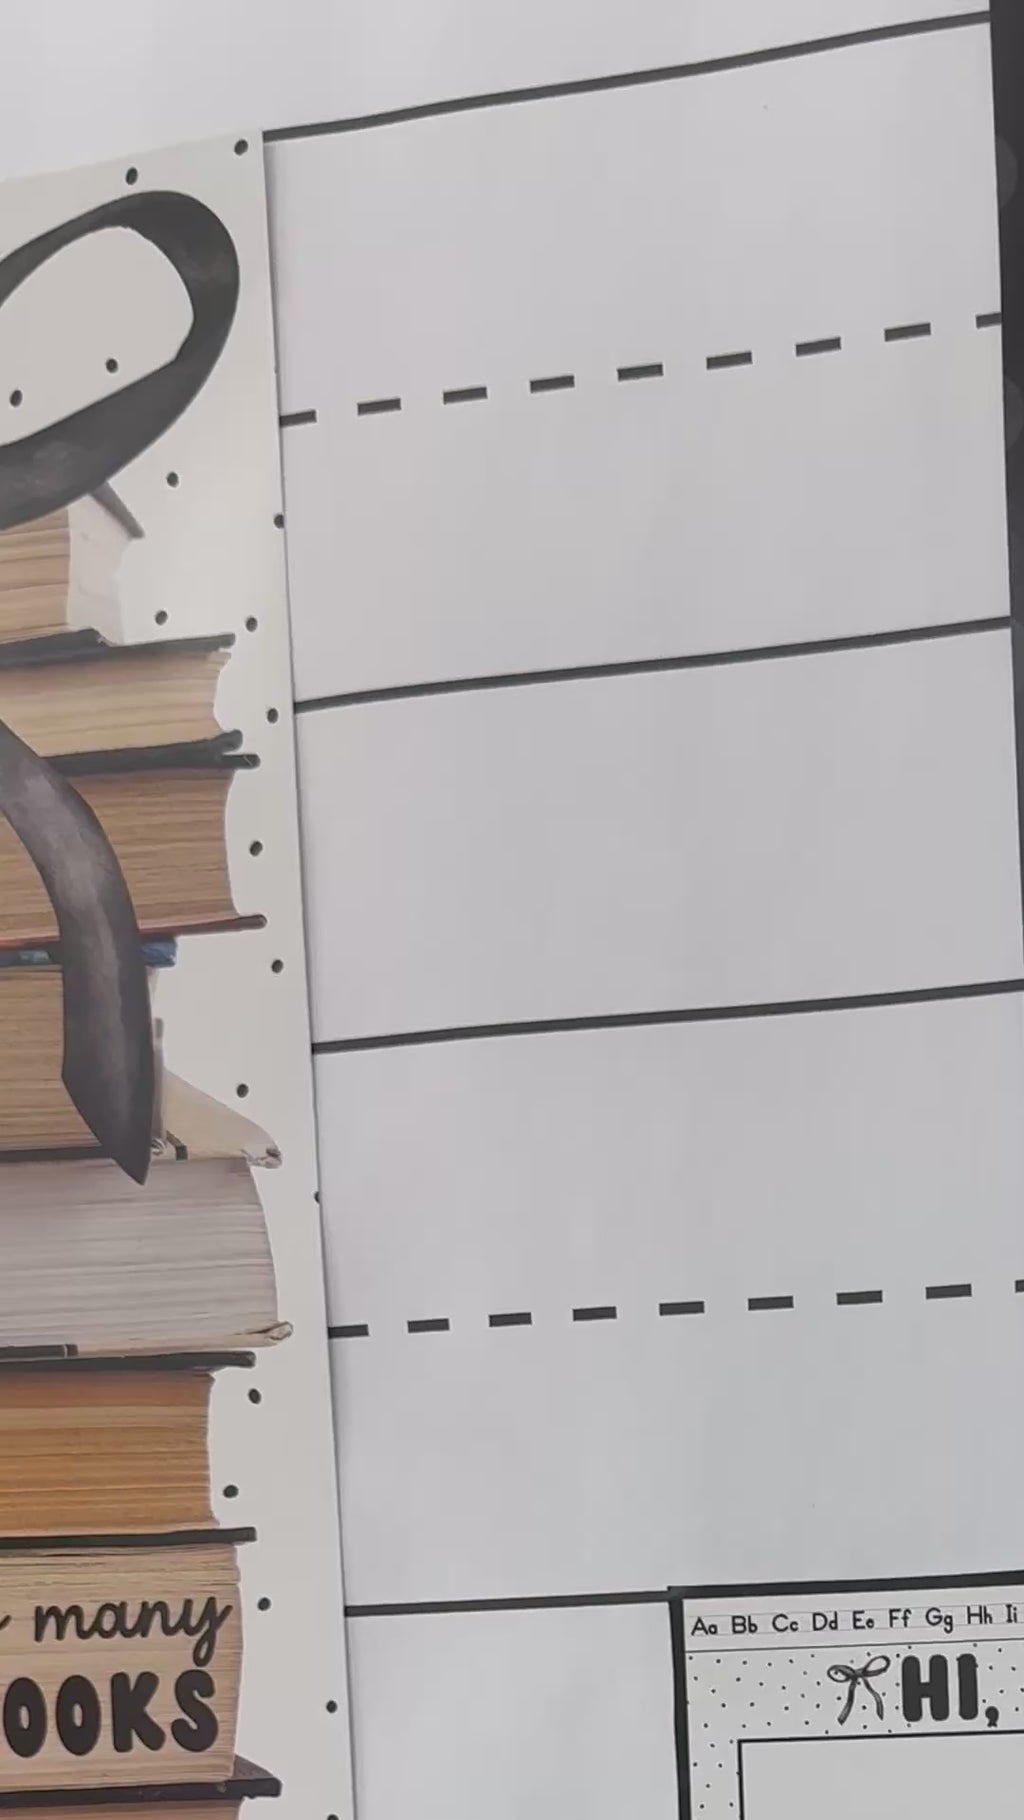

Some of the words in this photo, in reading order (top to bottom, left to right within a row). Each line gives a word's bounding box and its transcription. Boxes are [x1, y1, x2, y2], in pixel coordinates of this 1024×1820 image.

[33, 1596, 232, 1666] many
[690, 1615, 719, 1638] Aa
[731, 1615, 758, 1635] Bb
[771, 1613, 799, 1633] Cc
[812, 1610, 839, 1632] Dd
[852, 1609, 875, 1630] Ee
[888, 1607, 912, 1628] Ff
[924, 1606, 954, 1634] Gg
[966, 1604, 993, 1625] Hh
[1005, 1603, 1018, 1624] Ii
[901, 1653, 998, 1725] HI,
